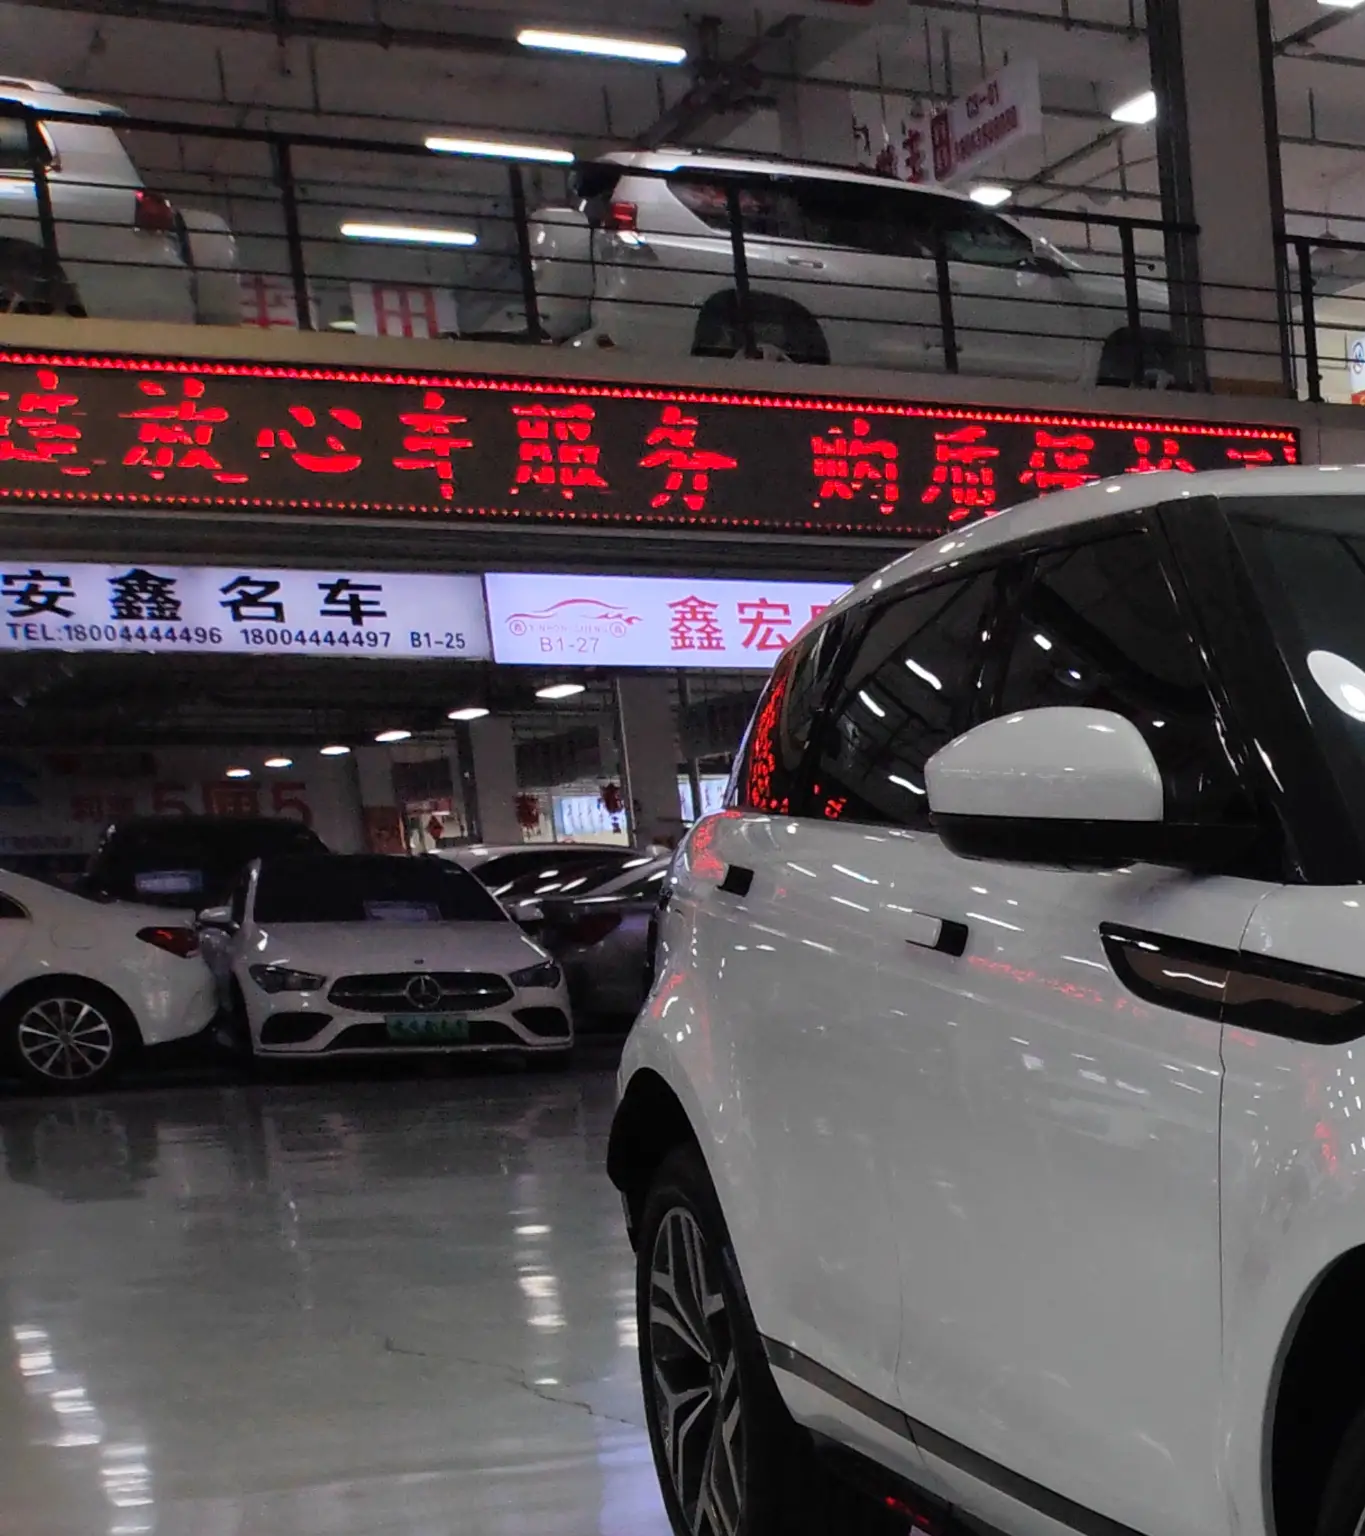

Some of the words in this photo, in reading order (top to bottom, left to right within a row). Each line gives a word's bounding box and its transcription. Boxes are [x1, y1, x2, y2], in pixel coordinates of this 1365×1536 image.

[0, 568, 388, 626] 安鑫名车
[240, 628, 392, 649] 18004444497
[410, 632, 467, 650] B1-25
[667, 594, 830, 652] 鑫宏
[539, 636, 600, 653] B1-27
